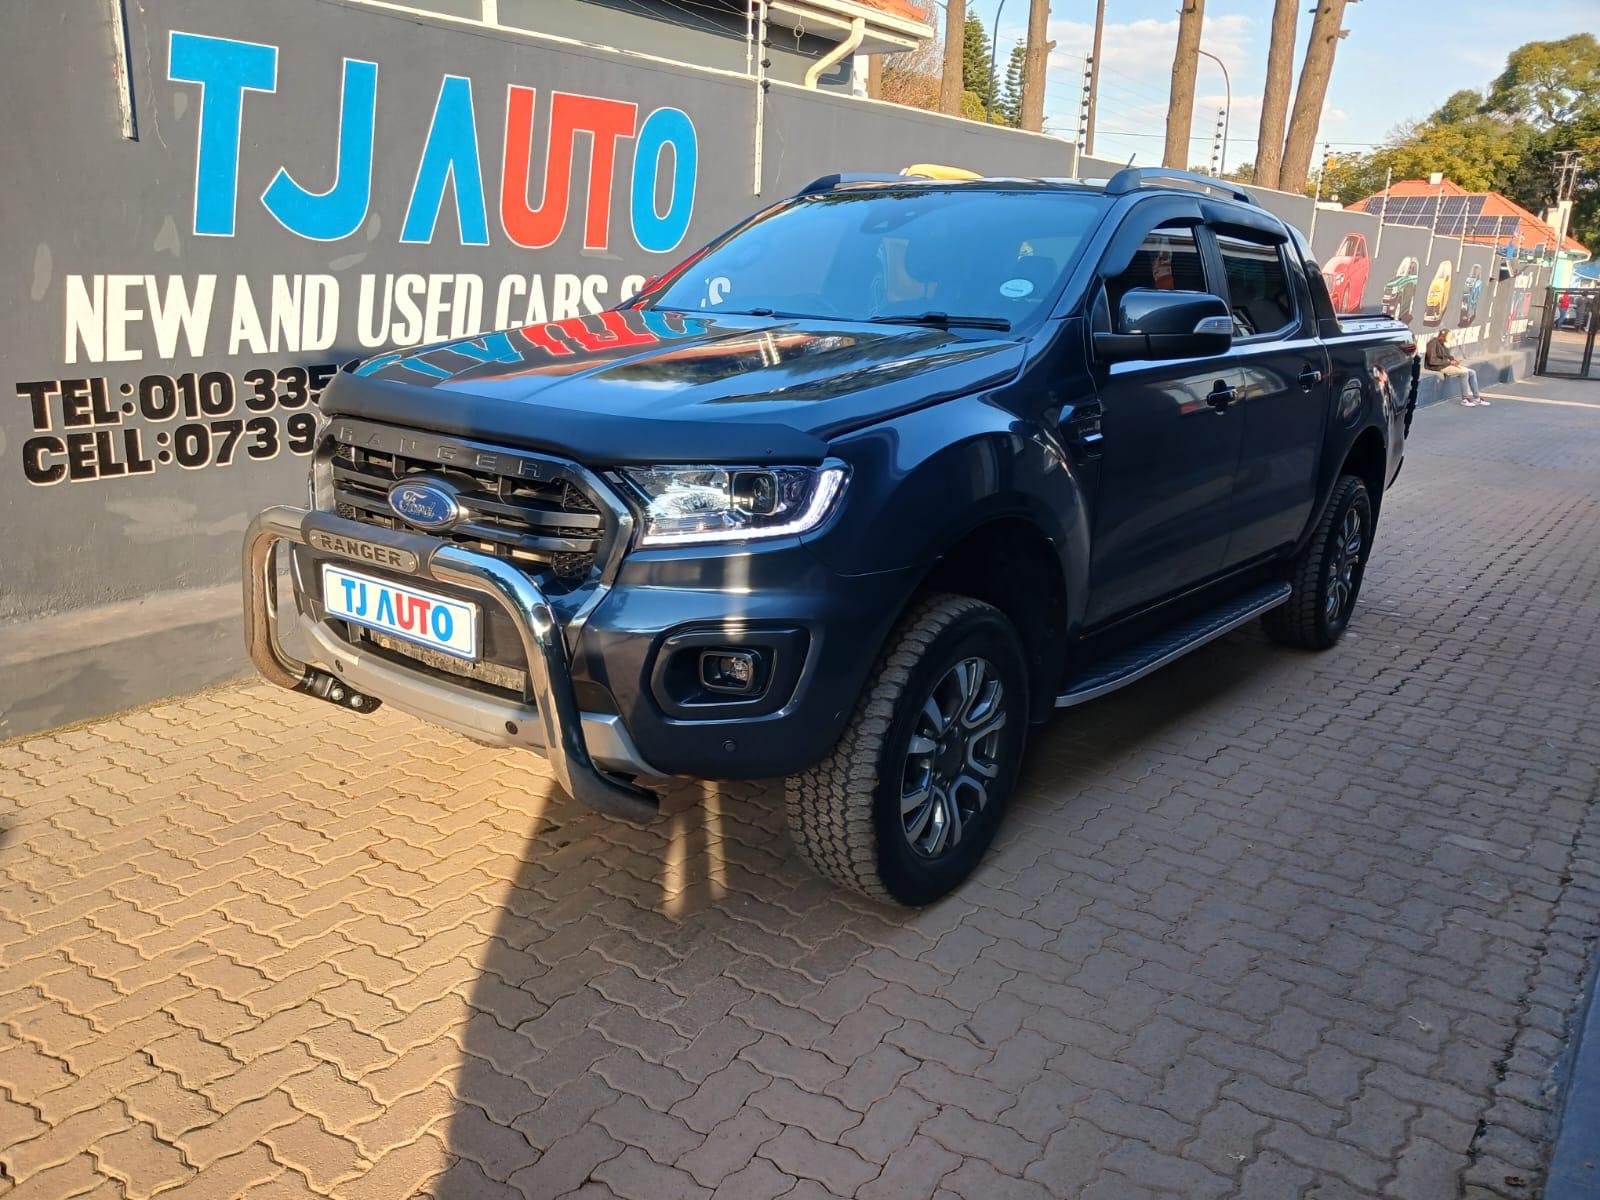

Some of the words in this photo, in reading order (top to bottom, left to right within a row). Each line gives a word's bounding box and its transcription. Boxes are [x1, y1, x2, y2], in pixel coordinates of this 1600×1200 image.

[167, 30, 379, 242] TJ
[399, 73, 699, 254] AUTO
[64, 273, 217, 364] NEW
[229, 273, 340, 356] AND
[358, 273, 485, 348] USED
[494, 273, 609, 331] CARS
[16, 371, 237, 432] TEL:010
[22, 415, 281, 487] CELL:073
[339, 425, 542, 479] RANGER
[399, 488, 437, 519] Ford
[319, 534, 403, 568] RANGER
[340, 577, 368, 617] TJ
[375, 587, 454, 642] AUTO
